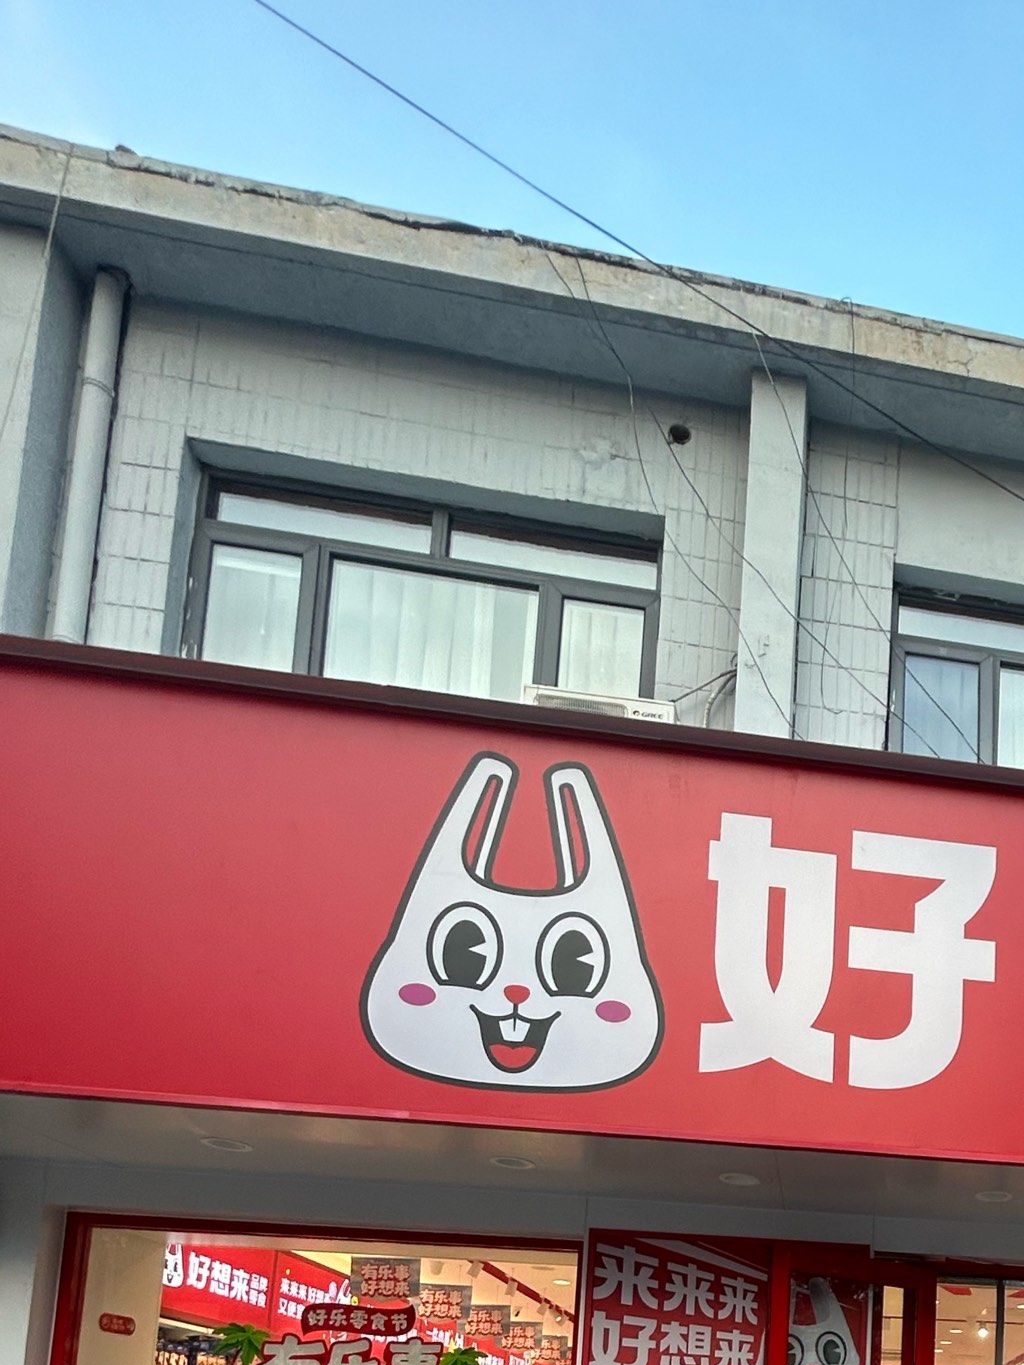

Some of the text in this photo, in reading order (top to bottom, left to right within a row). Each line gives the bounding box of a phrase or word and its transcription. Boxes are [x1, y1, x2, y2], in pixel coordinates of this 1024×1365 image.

[186, 1251, 250, 1303] 好想来
[360, 1263, 411, 1281] 有乐事
[360, 1280, 411, 1298] 好想来
[592, 1242, 759, 1326] 来来来
[419, 1289, 463, 1305] 有乐事
[307, 1308, 408, 1332] 好乐零食节
[418, 1303, 463, 1320] 好想来
